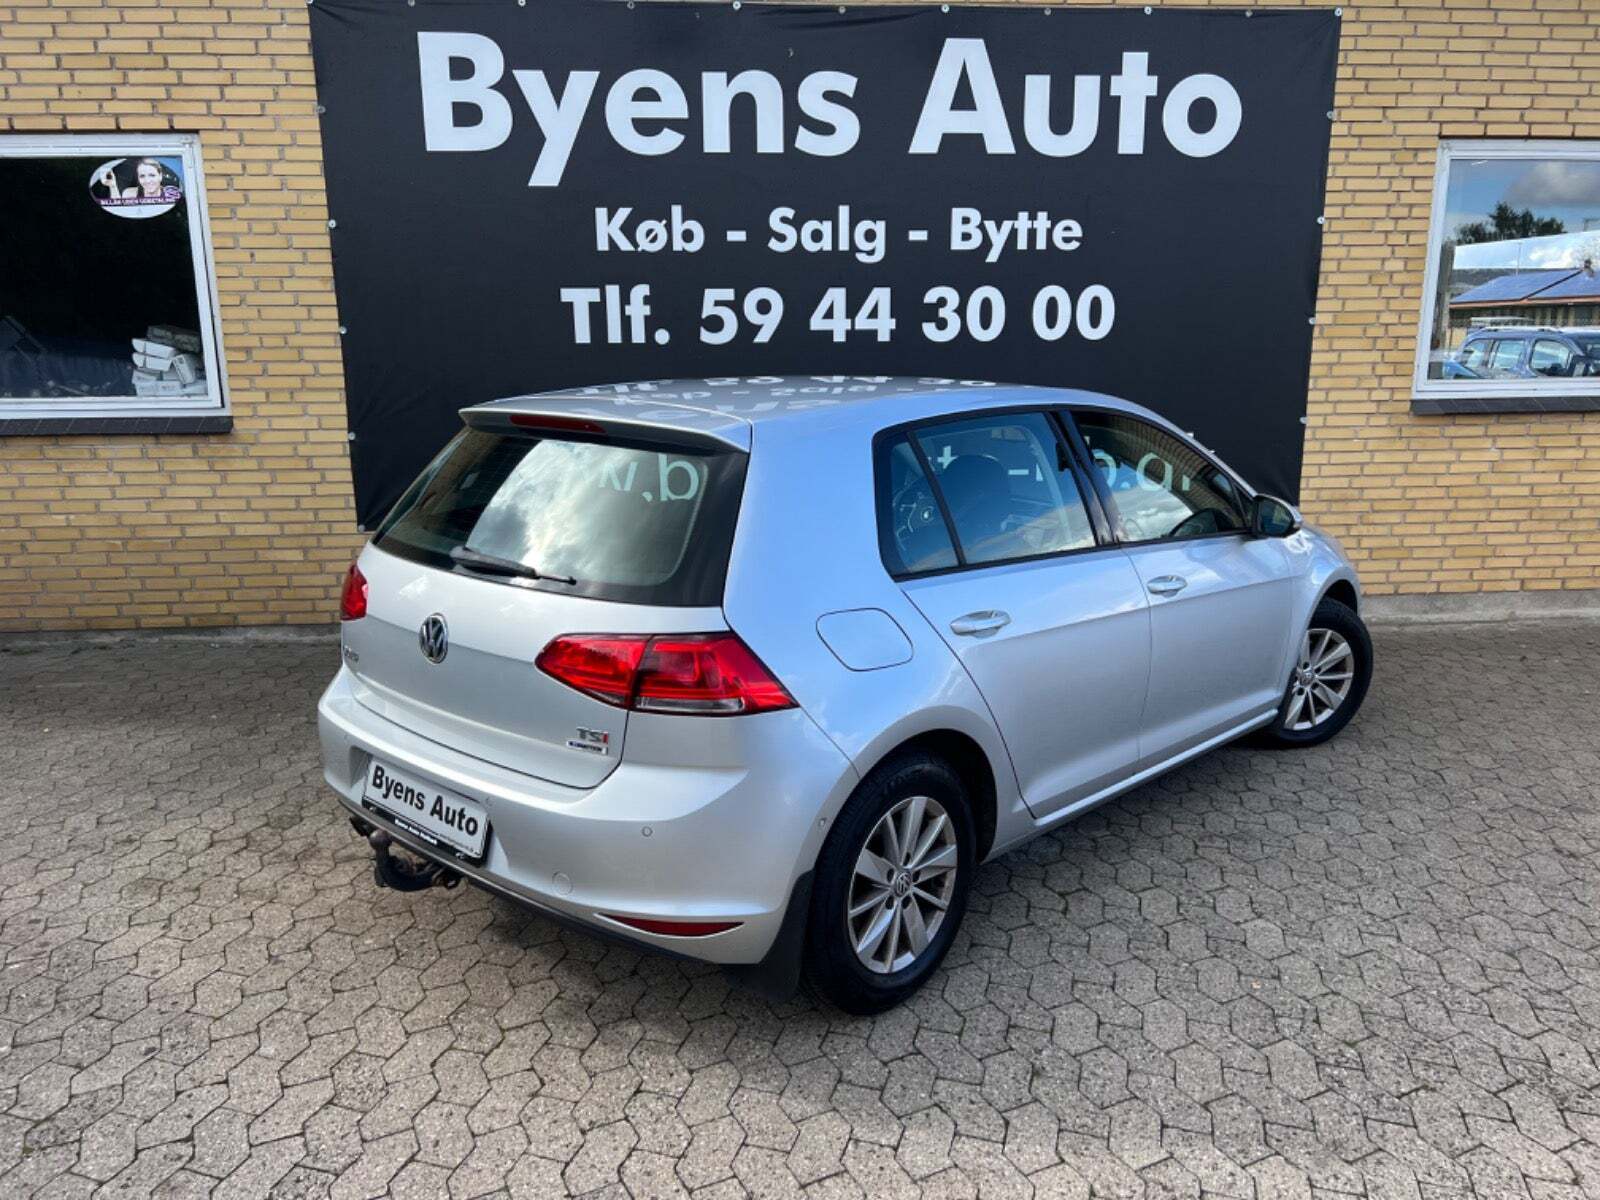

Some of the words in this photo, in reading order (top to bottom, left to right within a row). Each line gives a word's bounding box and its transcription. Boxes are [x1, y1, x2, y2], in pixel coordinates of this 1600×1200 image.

[417, 32, 861, 187] Byens
[908, 38, 1243, 158] Auto
[595, 205, 705, 253] Køb
[768, 205, 886, 264] Salg
[951, 208, 1083, 263] Bytte
[560, 284, 671, 345] Tlf.
[700, 287, 784, 345] 59
[810, 287, 897, 343] 44
[922, 286, 1006, 343] 30
[1033, 285, 1116, 341] 00
[372, 765, 426, 811] Byens
[430, 795, 478, 836] Auto
